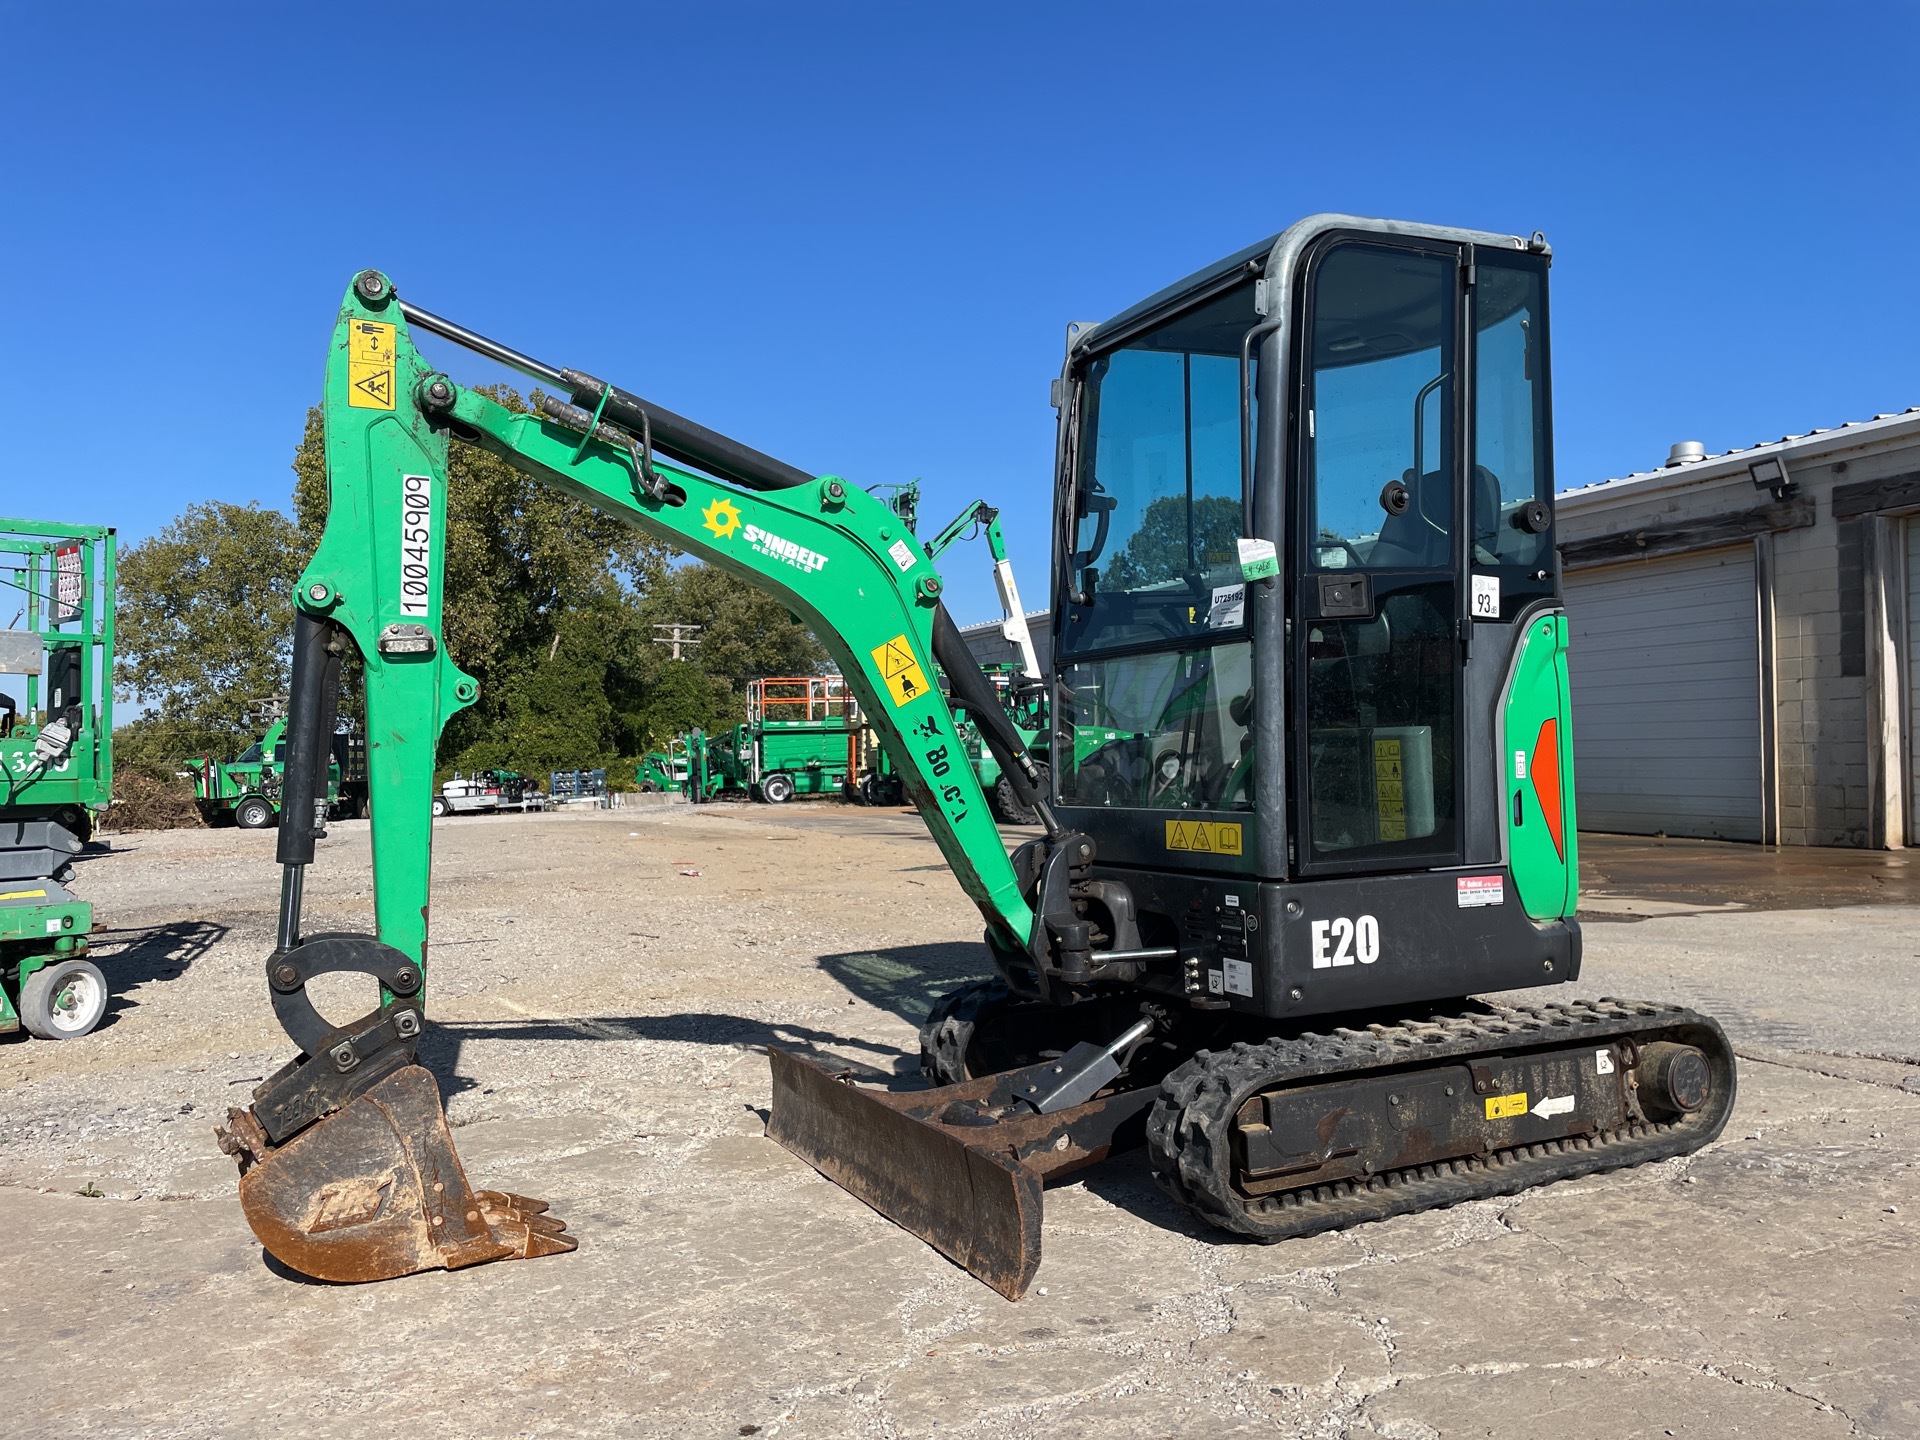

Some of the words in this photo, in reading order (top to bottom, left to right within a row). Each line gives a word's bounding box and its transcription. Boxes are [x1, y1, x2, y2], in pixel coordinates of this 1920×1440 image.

[402, 476, 430, 612] 10045909
[743, 524, 829, 572] SUNBELT
[752, 543, 812, 574] RENTALS
[1214, 591, 1244, 604] U725192
[1477, 593, 1491, 613] 93
[1311, 914, 1380, 969] E20
